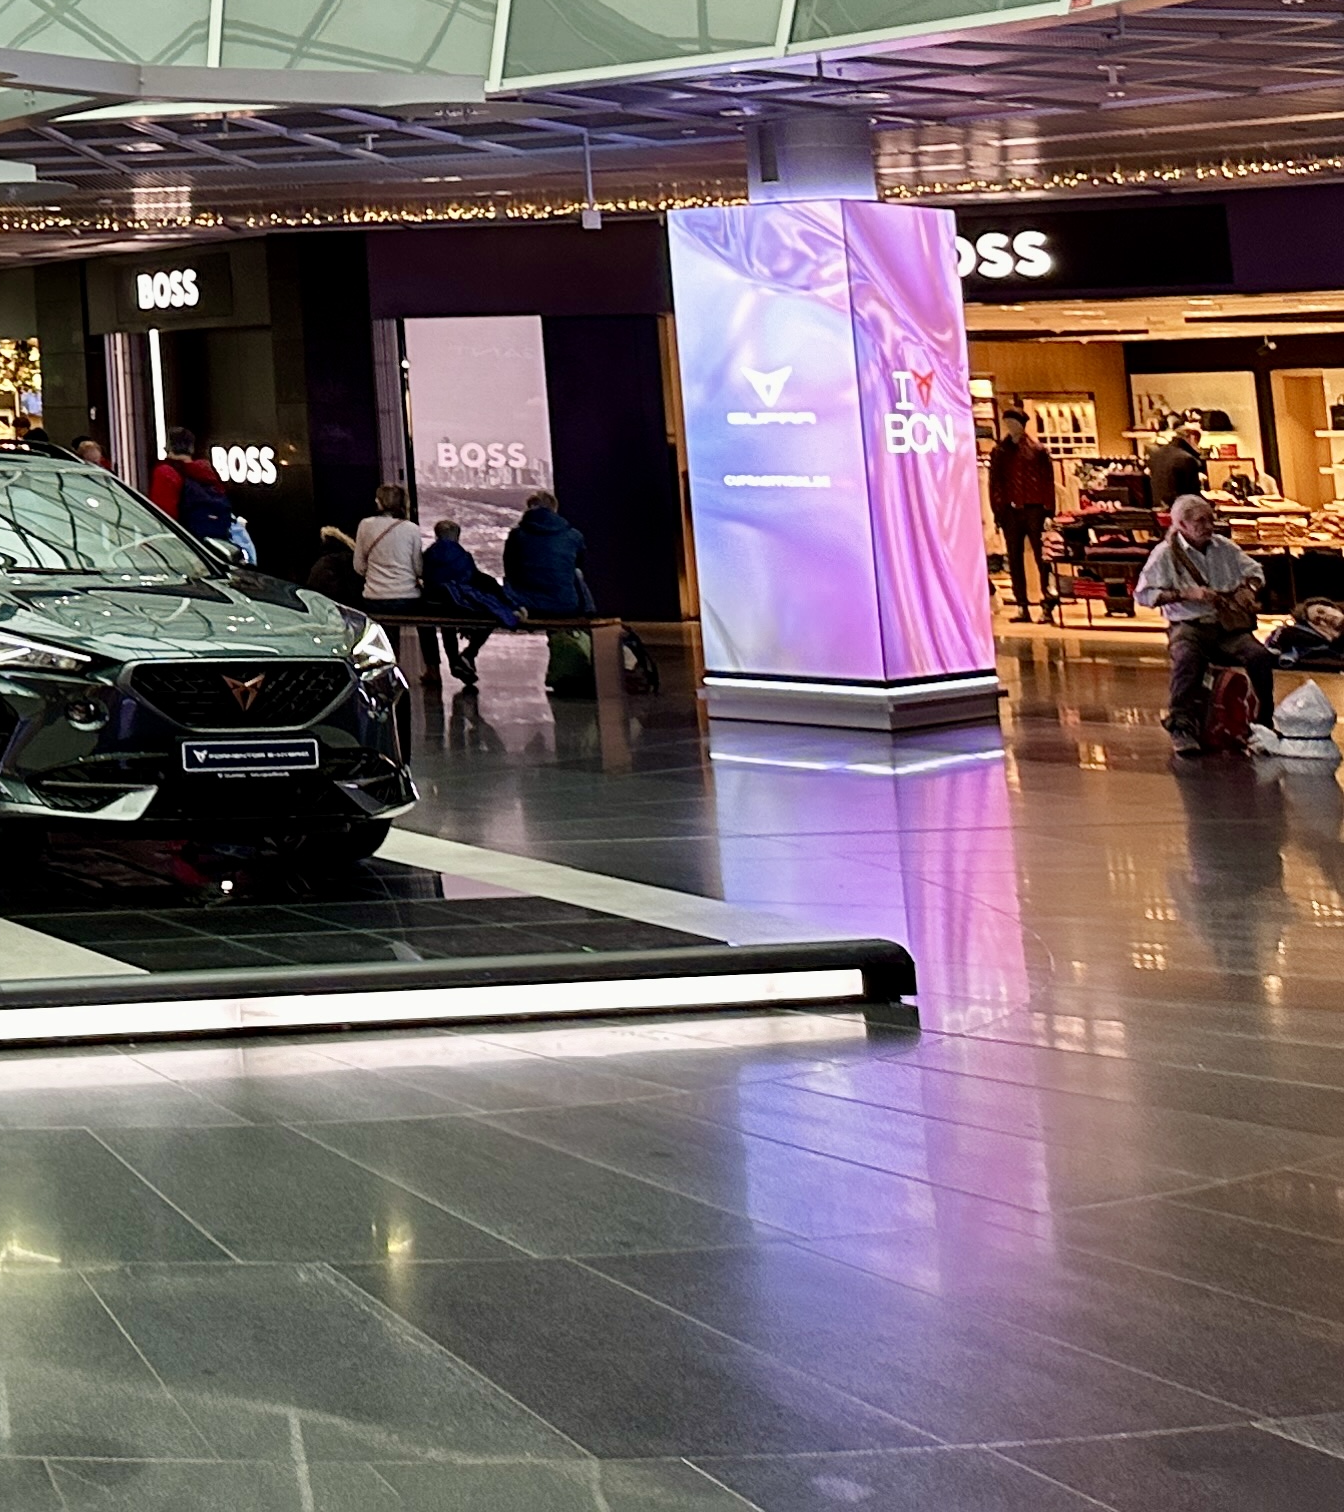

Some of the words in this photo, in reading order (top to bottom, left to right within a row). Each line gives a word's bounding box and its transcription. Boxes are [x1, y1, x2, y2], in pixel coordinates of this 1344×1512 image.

[136, 268, 200, 310] BOSS
[884, 412, 956, 455] BCN
[211, 445, 278, 485] BOSS
[436, 442, 528, 469] BOSS
